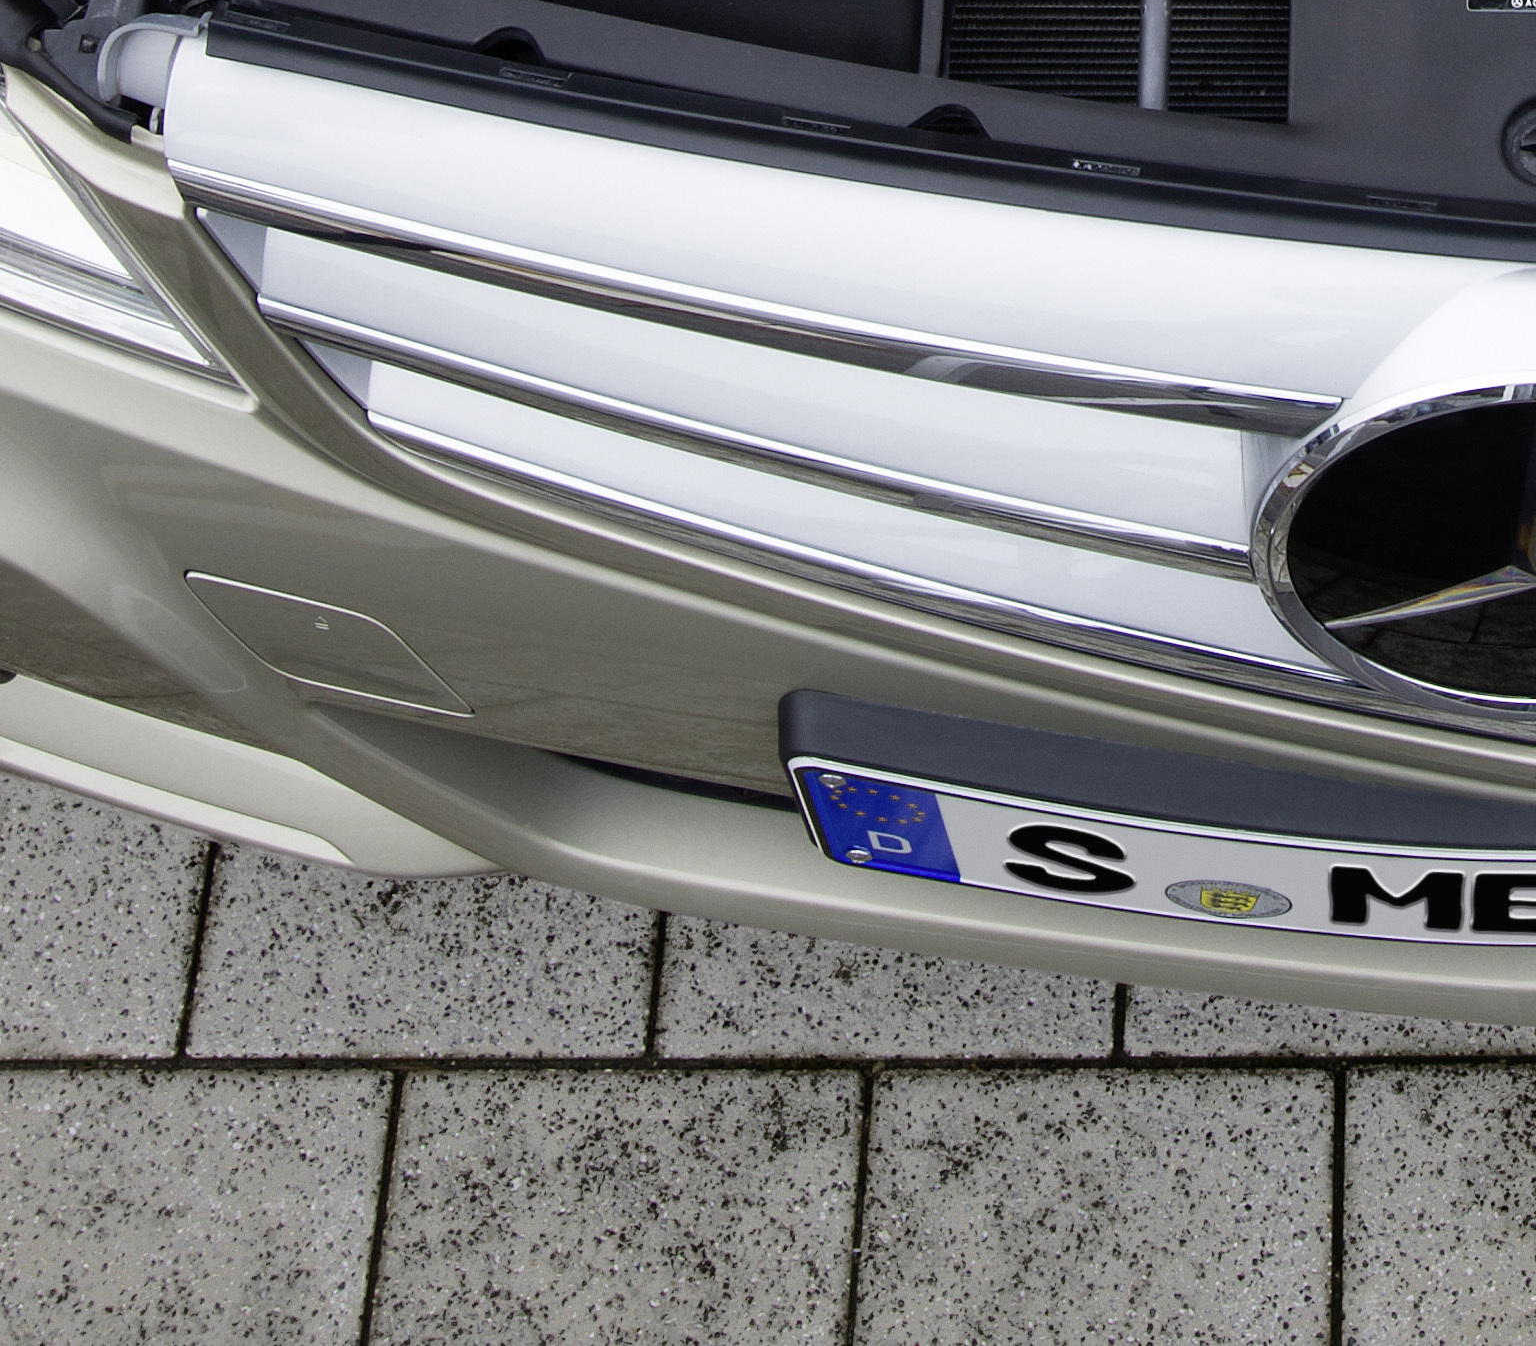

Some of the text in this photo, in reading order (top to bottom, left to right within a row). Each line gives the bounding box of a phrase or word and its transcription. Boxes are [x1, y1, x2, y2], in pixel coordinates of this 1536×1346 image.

[1525, 0, 1531, 8] A
[866, 830, 914, 858] D
[1001, 824, 1137, 896] S
